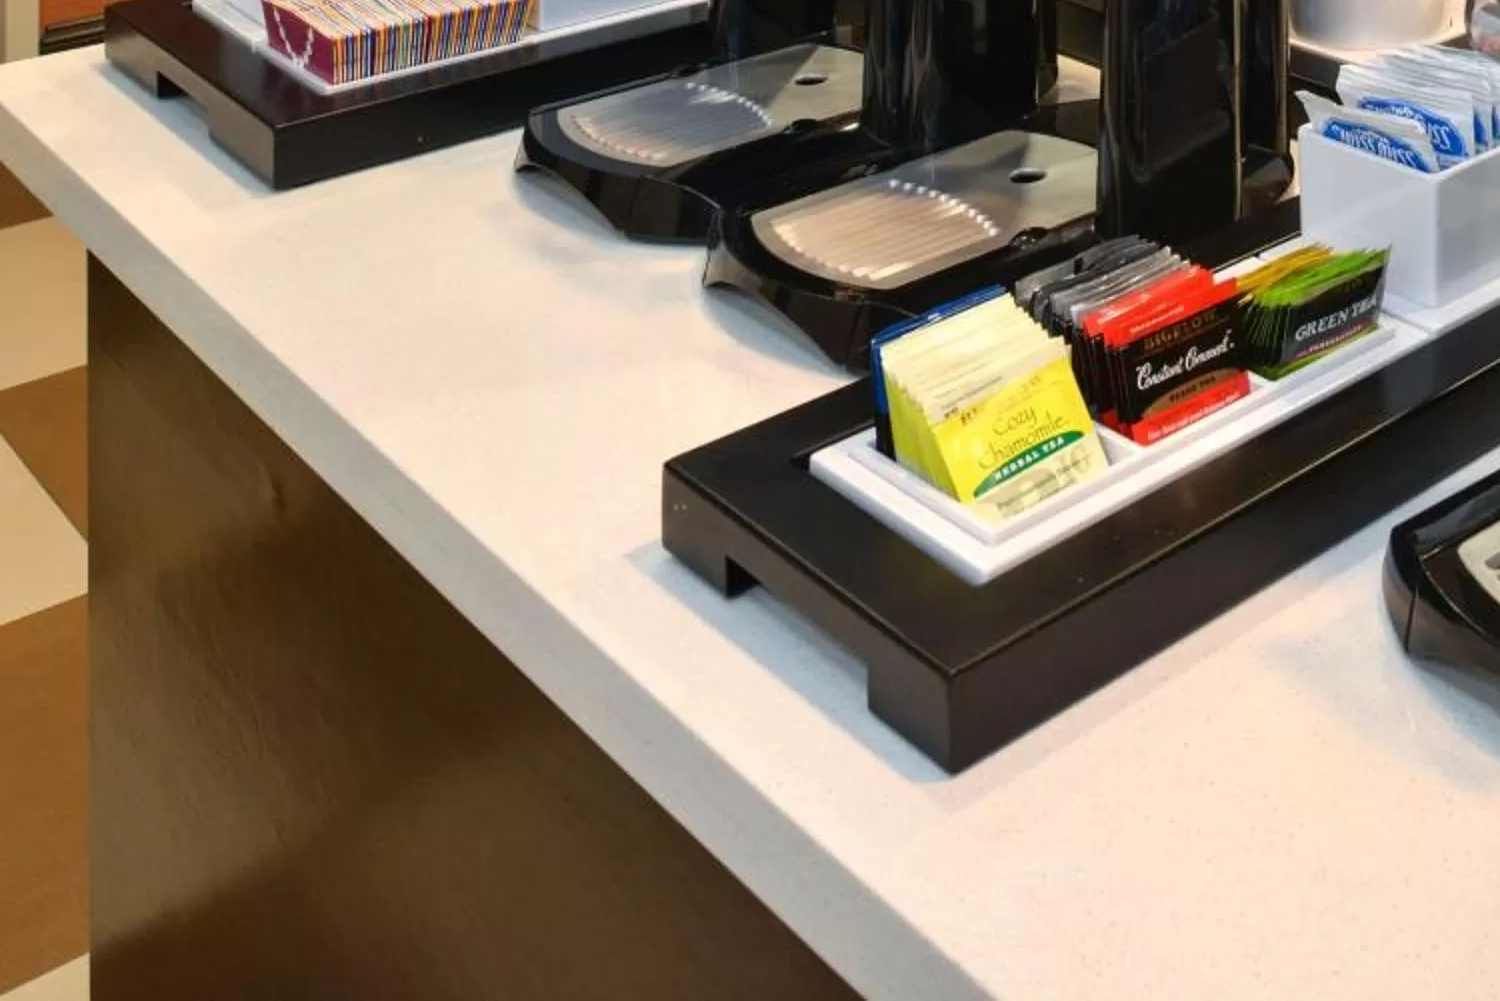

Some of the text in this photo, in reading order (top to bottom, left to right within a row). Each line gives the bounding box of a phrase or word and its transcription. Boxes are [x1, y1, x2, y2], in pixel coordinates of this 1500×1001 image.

[1295, 307, 1350, 341] GREEN
[991, 406, 1038, 436] Cozy
[994, 436, 1065, 481] HERBAL TEA
